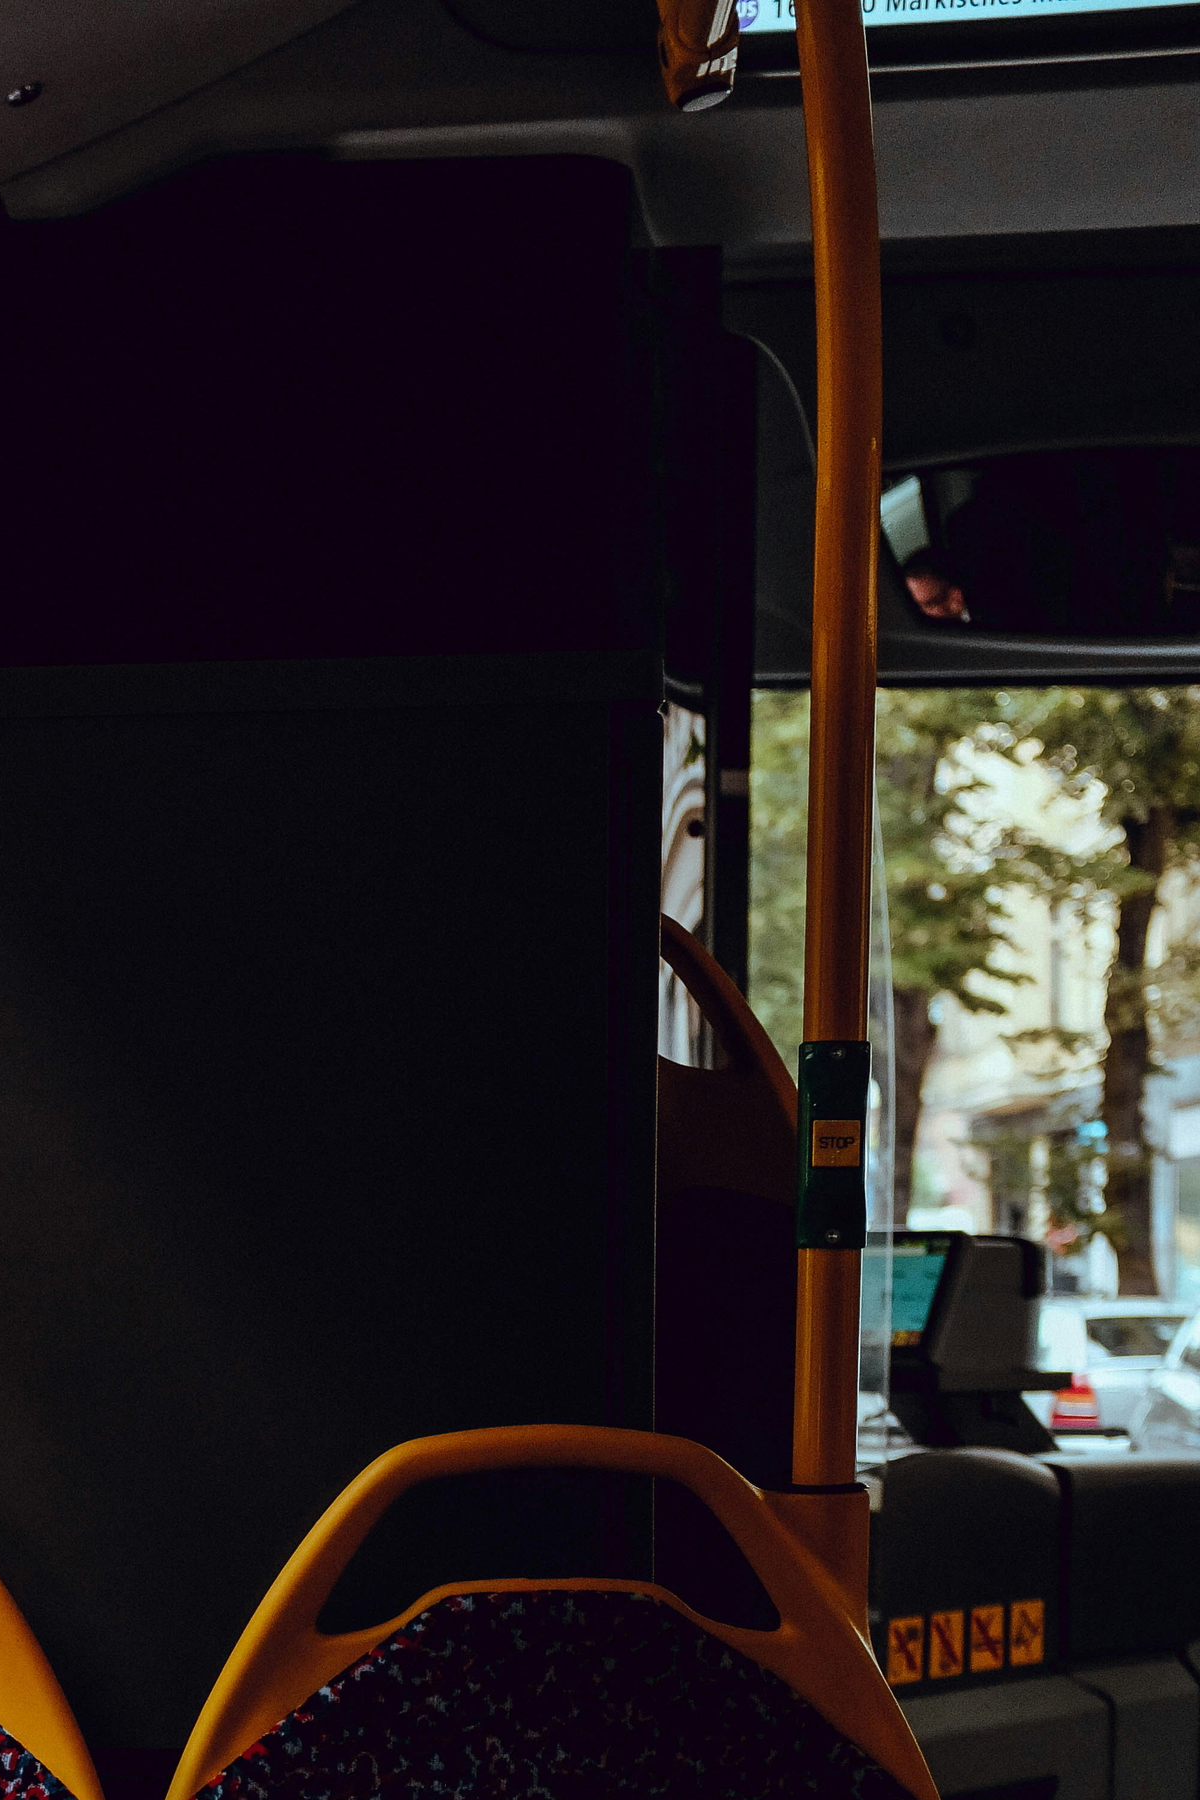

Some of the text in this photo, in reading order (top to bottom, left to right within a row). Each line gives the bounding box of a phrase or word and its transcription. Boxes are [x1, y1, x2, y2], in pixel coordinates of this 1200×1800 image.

[735, 0, 758, 18] US
[773, 0, 796, 18] 16
[819, 1136, 855, 1149] STOP
